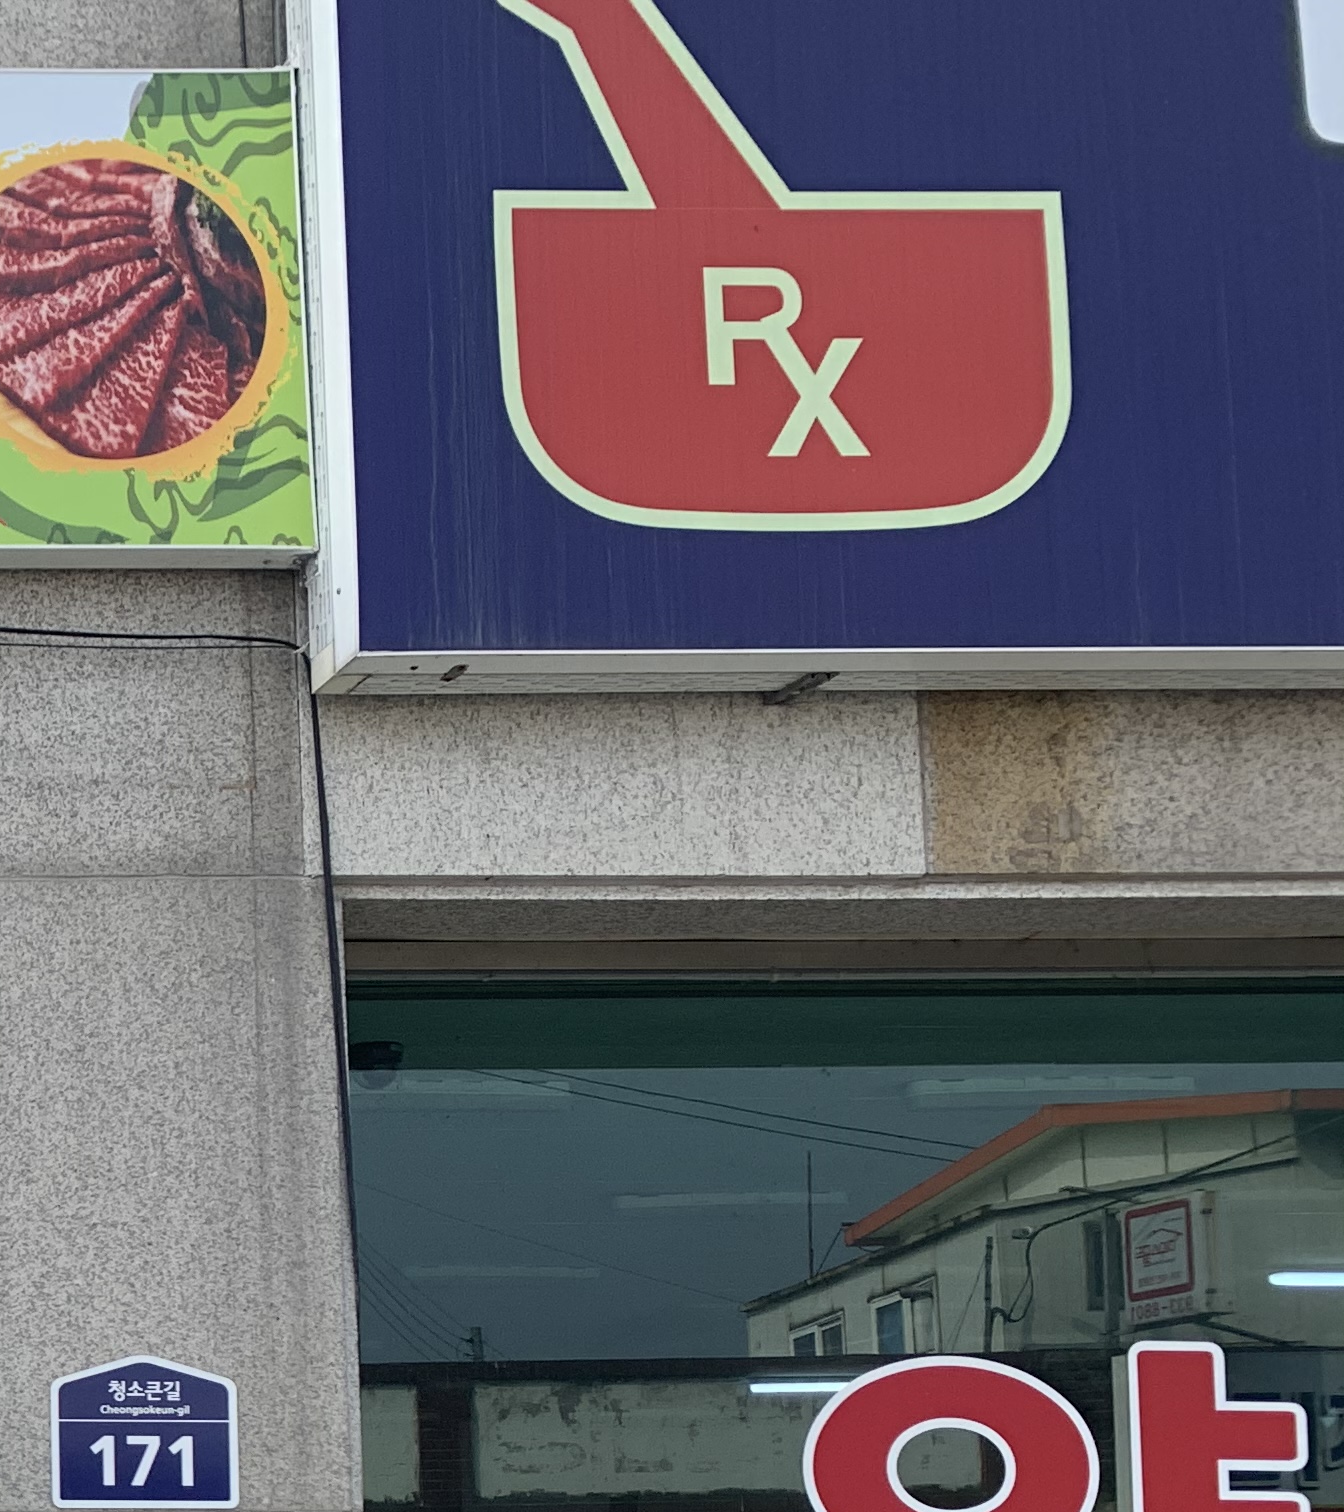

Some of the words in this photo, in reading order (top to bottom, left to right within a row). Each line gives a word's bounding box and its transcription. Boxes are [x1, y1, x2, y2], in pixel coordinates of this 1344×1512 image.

[107, 1380, 181, 1402] 청소큰길
[99, 1404, 191, 1417] Cheongsokeun-gil
[89, 1435, 195, 1487] 171
